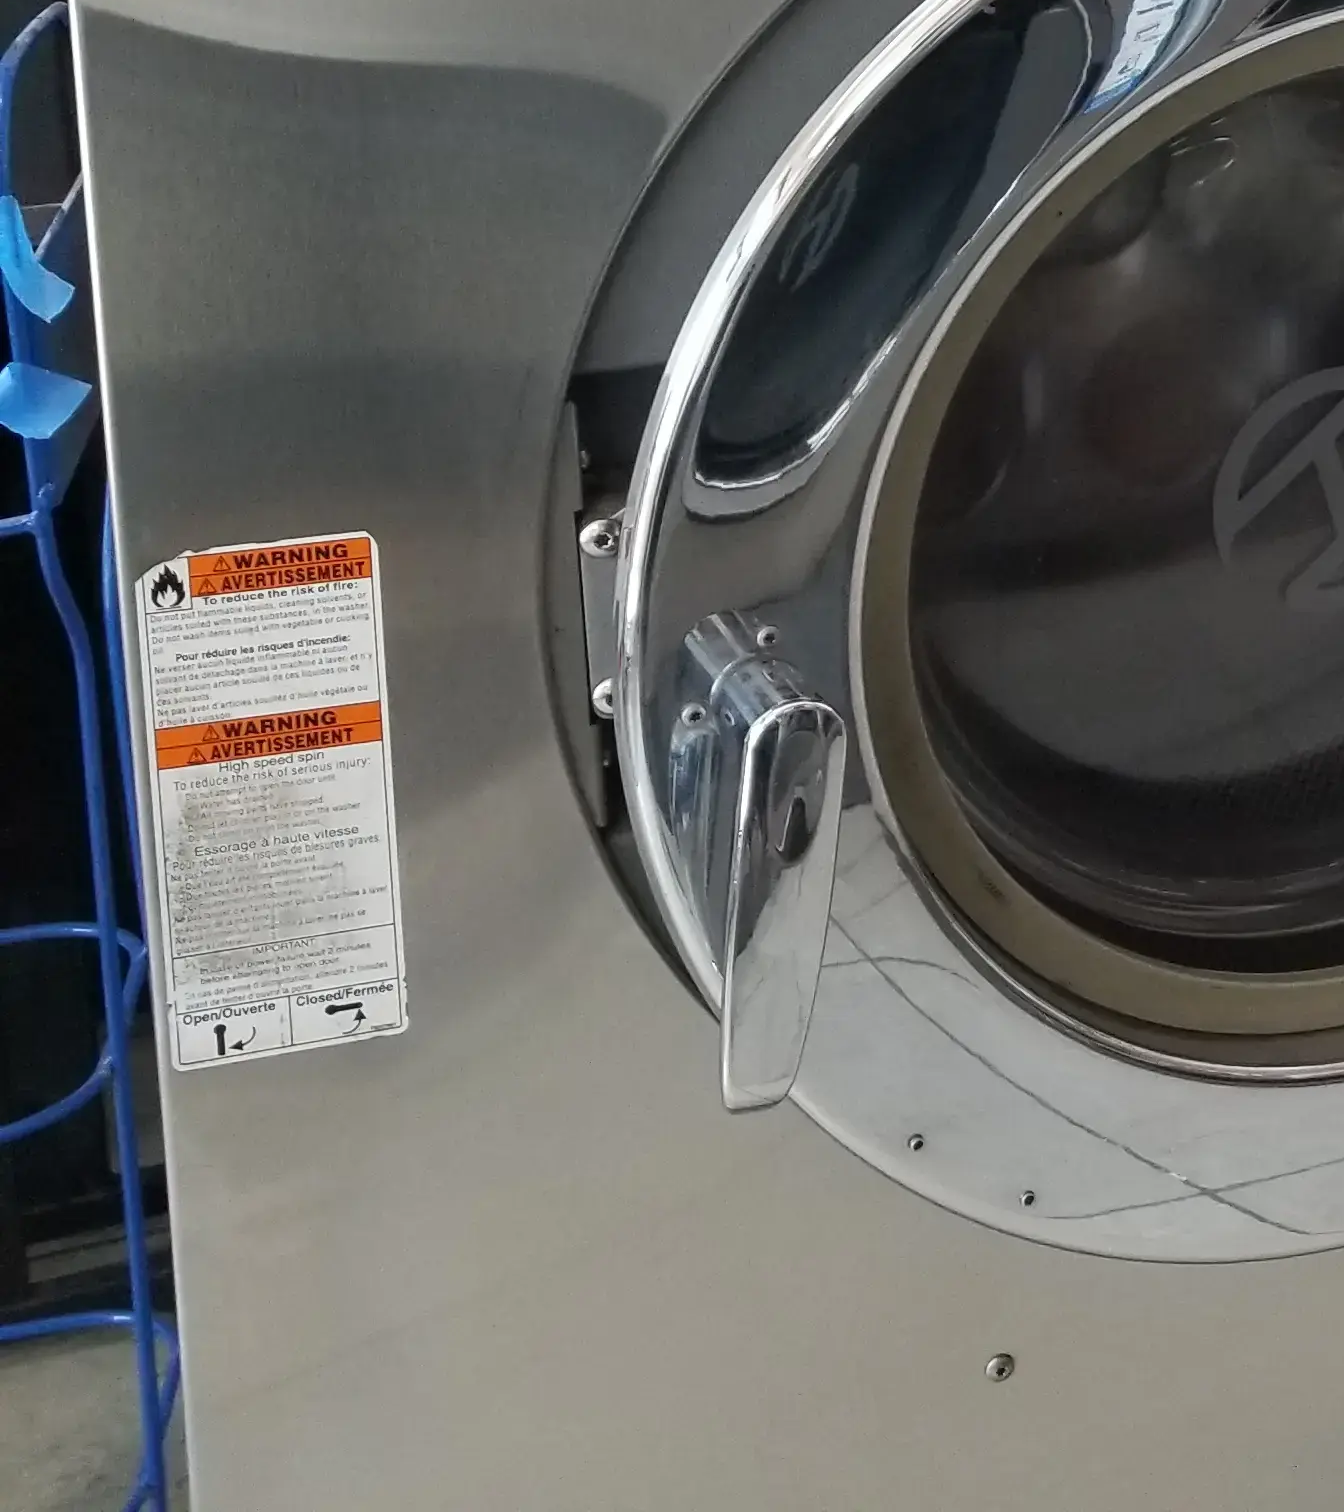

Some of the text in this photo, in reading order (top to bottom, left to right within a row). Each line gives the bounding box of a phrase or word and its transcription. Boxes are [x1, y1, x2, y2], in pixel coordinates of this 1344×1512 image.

[233, 543, 348, 570] WARNING
[221, 561, 365, 592] AVERTISSEMENT
[203, 581, 358, 606] To reduce the risk of fire:
[176, 653, 199, 662] Pour
[202, 648, 238, 659] réduire
[240, 645, 255, 654] les
[258, 640, 294, 653] risques
[222, 710, 337, 738] WARNING
[210, 727, 354, 761] AVERTISSEMENT
[219, 751, 325, 775] High speed spin
[174, 781, 187, 791] To
[190, 776, 228, 789] reduce
[232, 774, 249, 784] the
[253, 769, 274, 780] risk
[278, 767, 289, 778] of
[292, 762, 332, 776] serious
[194, 825, 359, 857] Essorage à haute vitesse
[172, 860, 195, 872] Pour
[253, 938, 315, 955] IMPORTANT
[296, 981, 394, 1007] Closed/Fermée
[182, 1002, 276, 1026] Open/Ouverte
